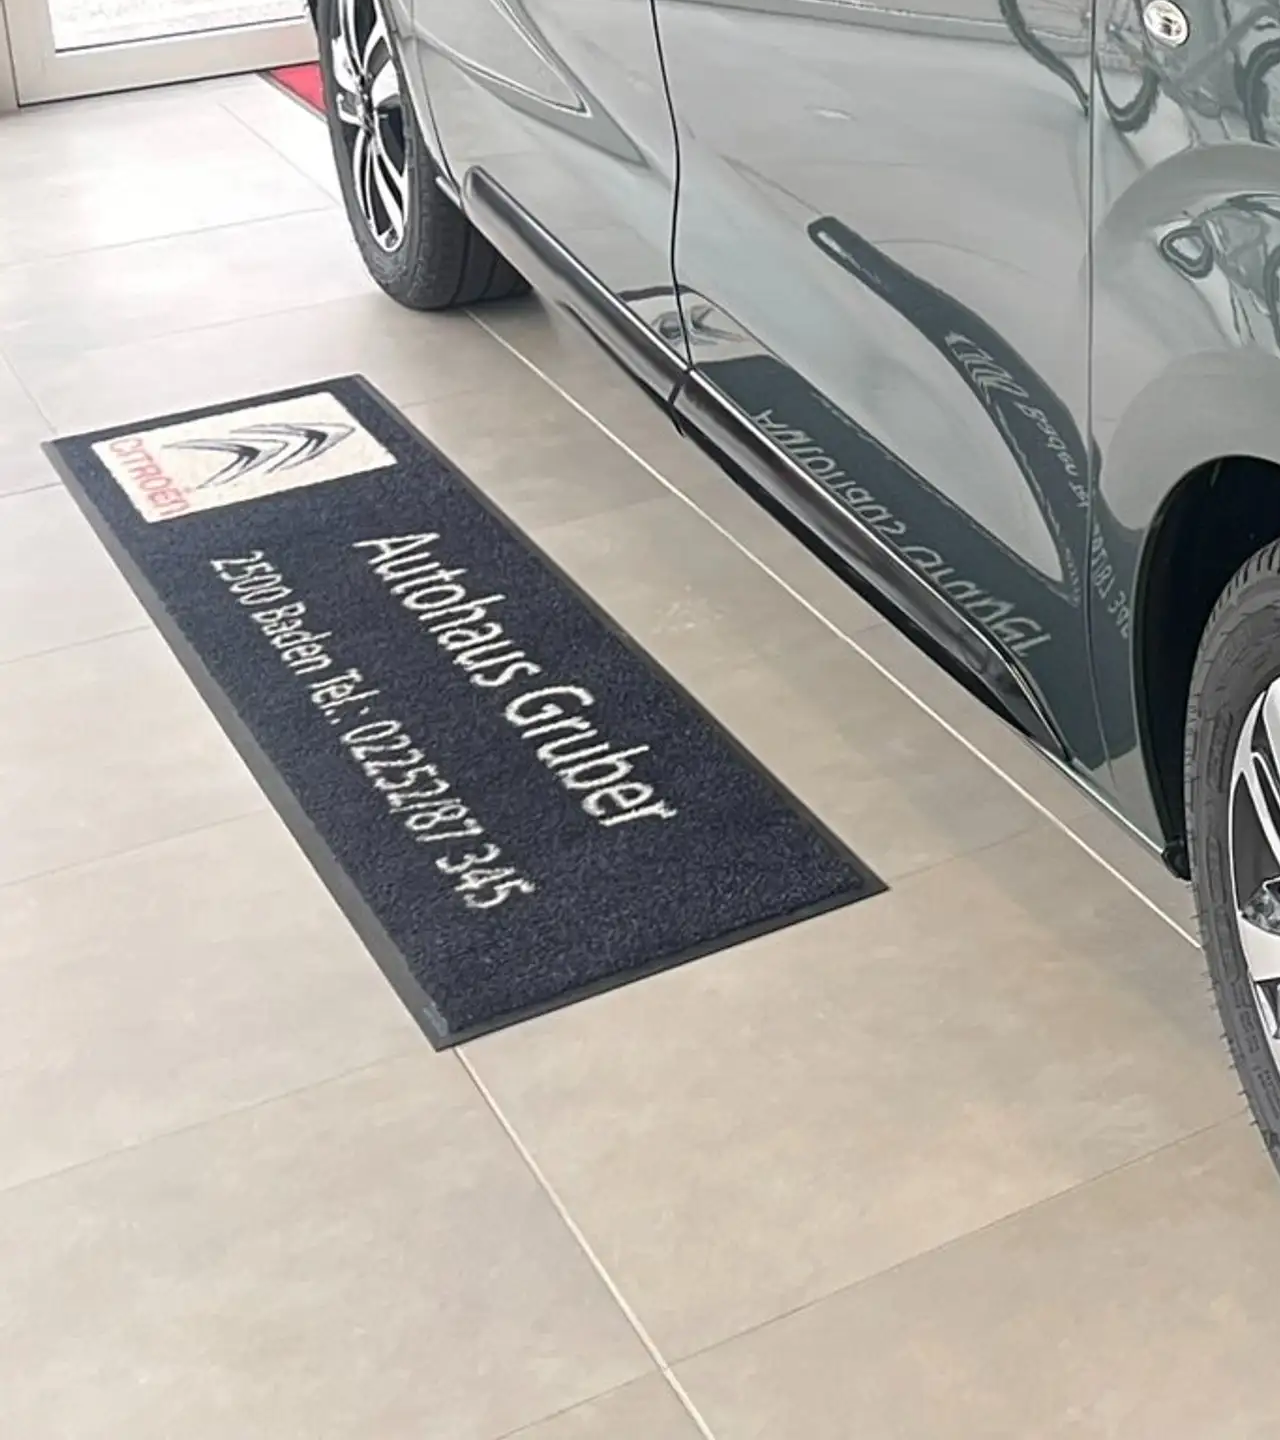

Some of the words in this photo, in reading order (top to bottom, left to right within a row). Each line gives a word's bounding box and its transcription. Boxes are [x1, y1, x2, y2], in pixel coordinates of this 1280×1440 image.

[211, 550, 292, 605] 2500
[252, 600, 332, 676] Baden
[339, 719, 484, 842] 02252/87
[435, 842, 536, 909] 345
[353, 532, 541, 688] Autohaus
[504, 684, 678, 827] Gruber
